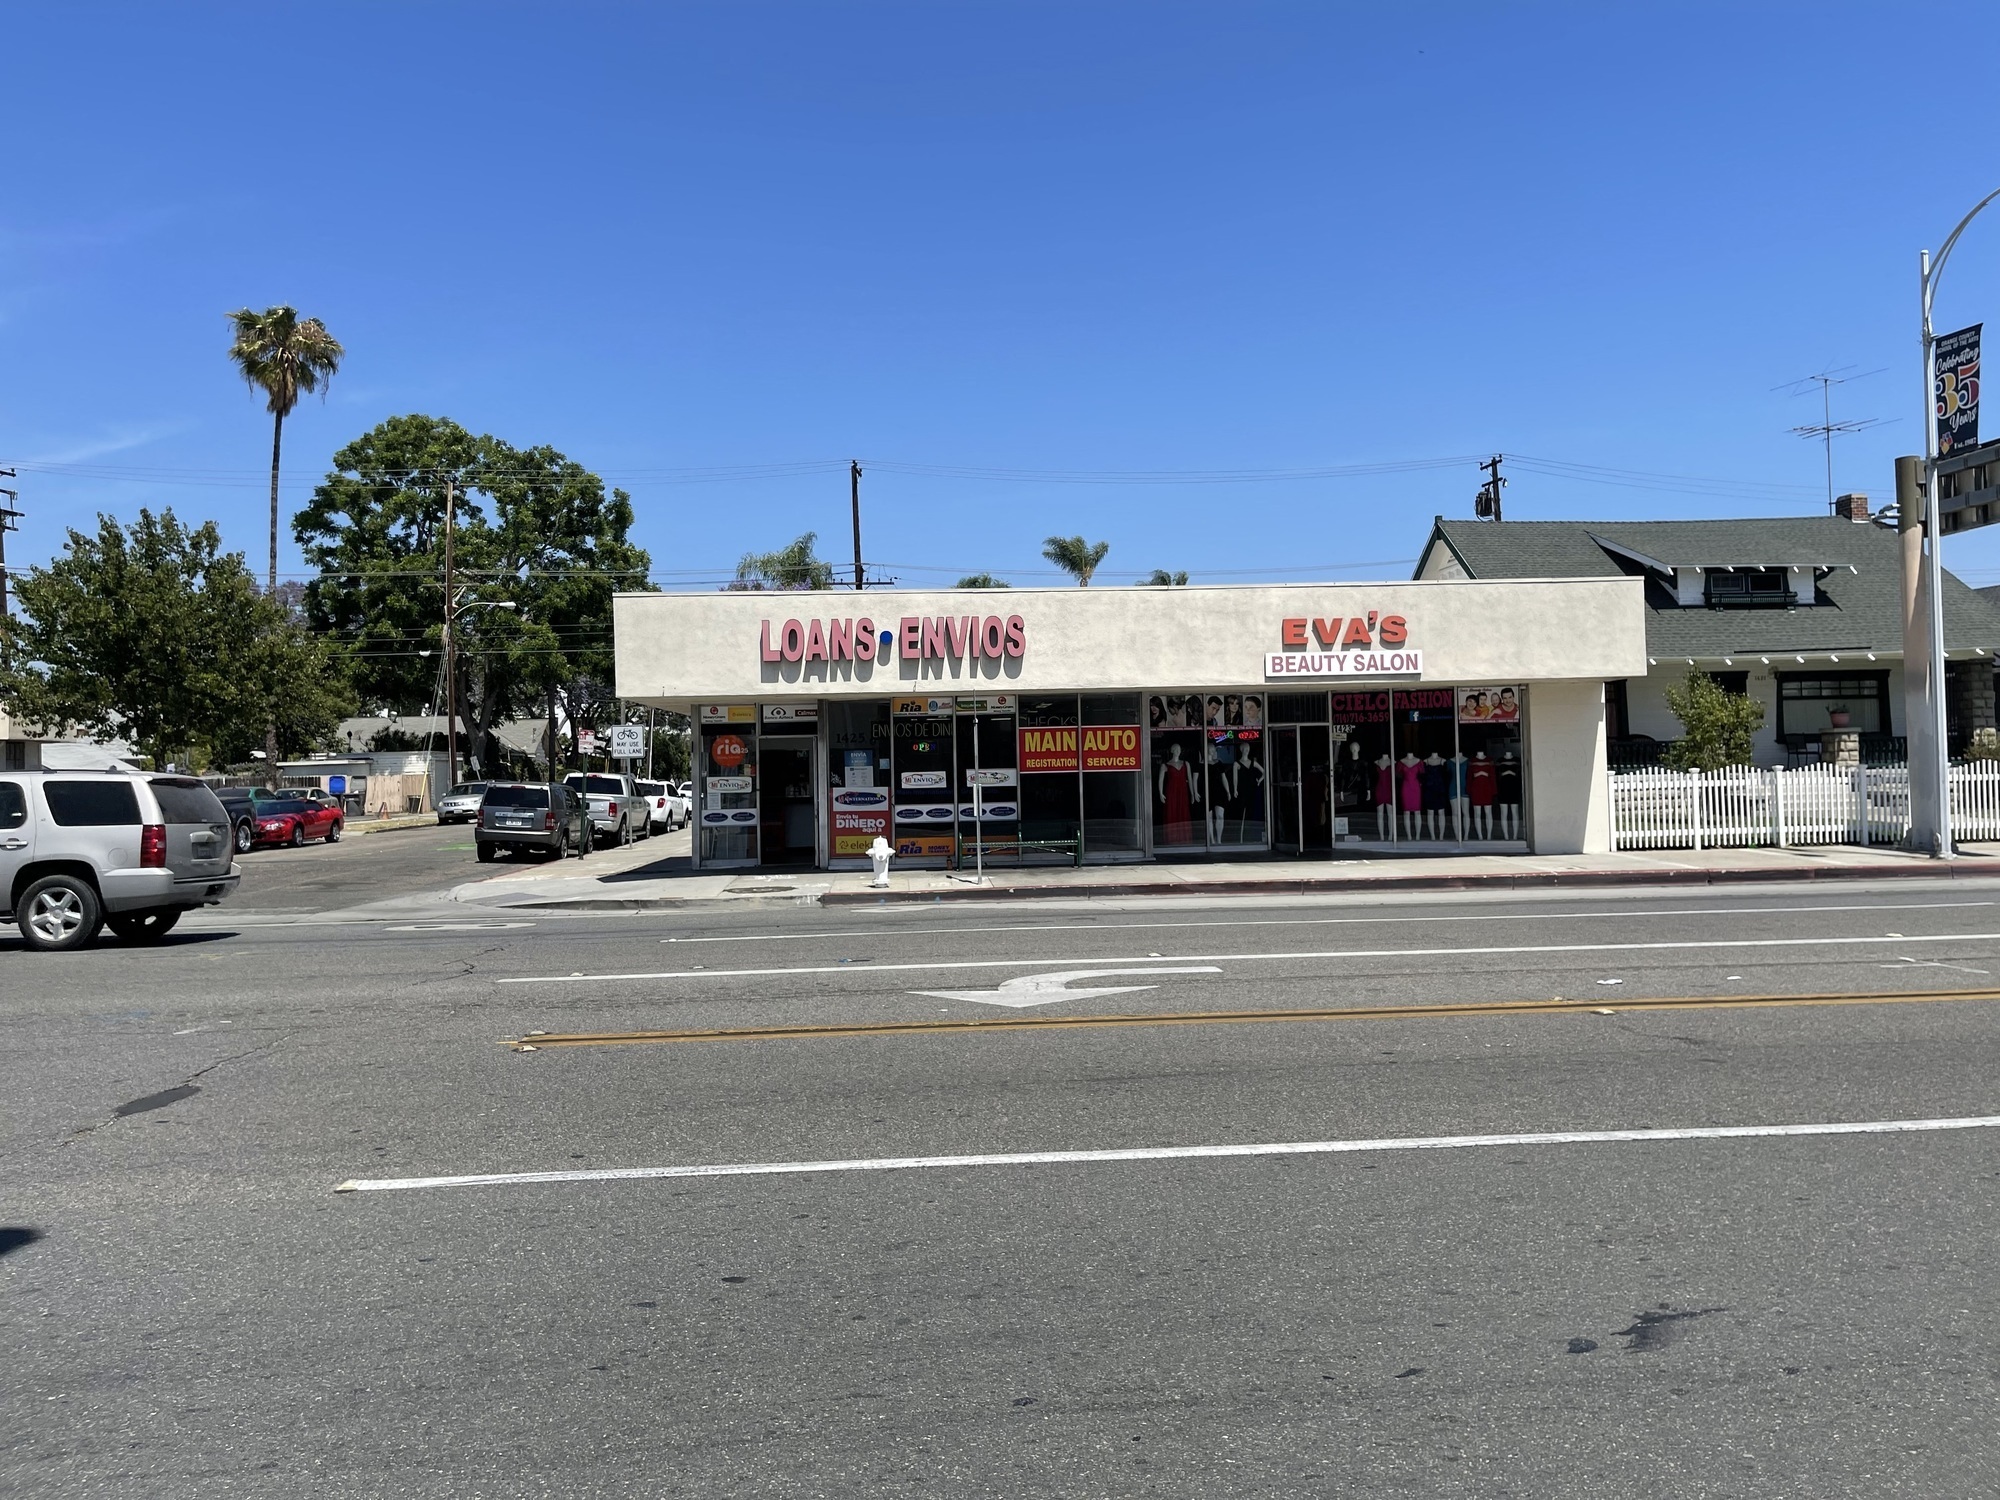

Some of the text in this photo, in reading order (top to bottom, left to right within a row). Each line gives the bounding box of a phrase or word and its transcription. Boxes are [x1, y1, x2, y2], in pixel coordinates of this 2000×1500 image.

[1936, 347, 1979, 375] Celebrating
[1936, 358, 1980, 419] 35
[1950, 407, 1977, 433] Years
[1282, 611, 1408, 645] EVA'S
[761, 614, 1027, 662] LOANS ENVIOS
[1271, 653, 1418, 673] BEAUTY SALON
[900, 700, 922, 712] Ria
[1331, 690, 1453, 711] CIELO FASHION
[914, 722, 929, 737] DE
[1334, 724, 1352, 733] 1423
[836, 733, 865, 743] 1425
[1024, 729, 1136, 752] MAIN AUTO
[912, 743, 937, 752] OPEN
[1026, 756, 1136, 768] REGISTRATION SERVICES
[836, 818, 886, 829] DINERO
[850, 840, 874, 850] elekt
[900, 841, 922, 854] Ria
